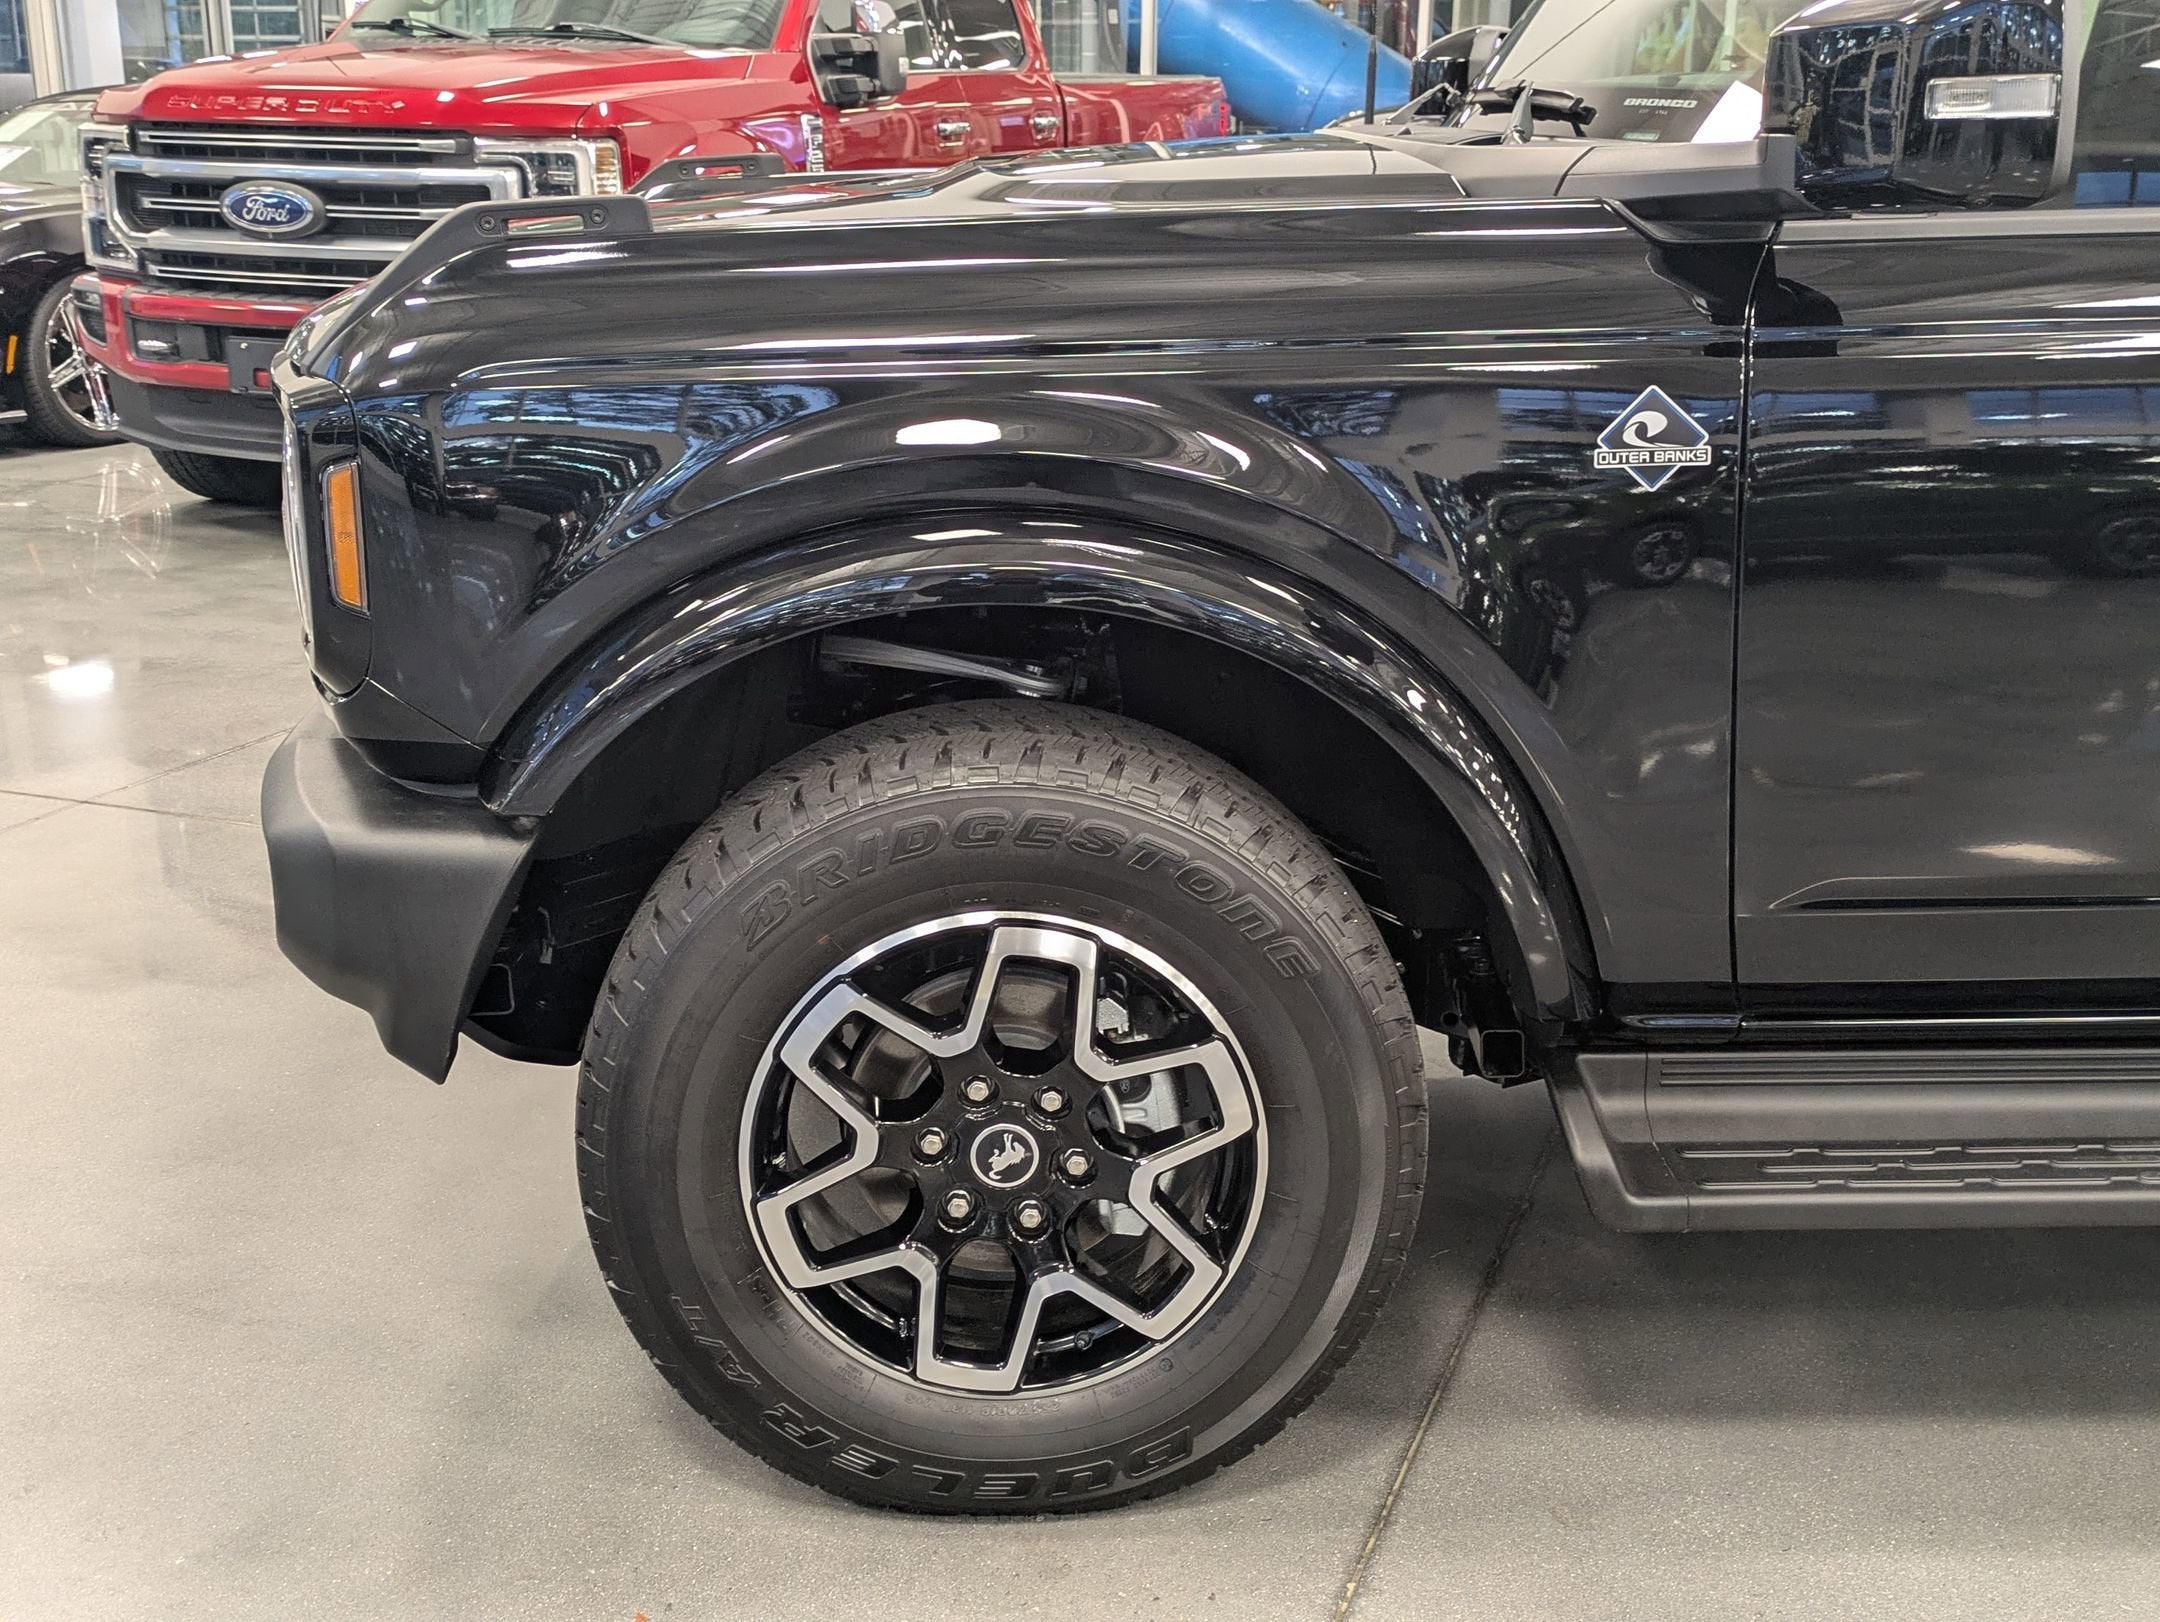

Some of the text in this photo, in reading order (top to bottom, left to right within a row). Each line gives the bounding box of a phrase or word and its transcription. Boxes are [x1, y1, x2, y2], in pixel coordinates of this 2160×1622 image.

[168, 95, 405, 114] SUPER DUTY
[1623, 97, 1698, 109] BRONCO
[242, 195, 290, 222] Ford
[1599, 449, 1707, 465] OUTER BANKS
[738, 807, 1321, 978] BRIDGESTONE
[759, 1402, 1192, 1500] DUELER
